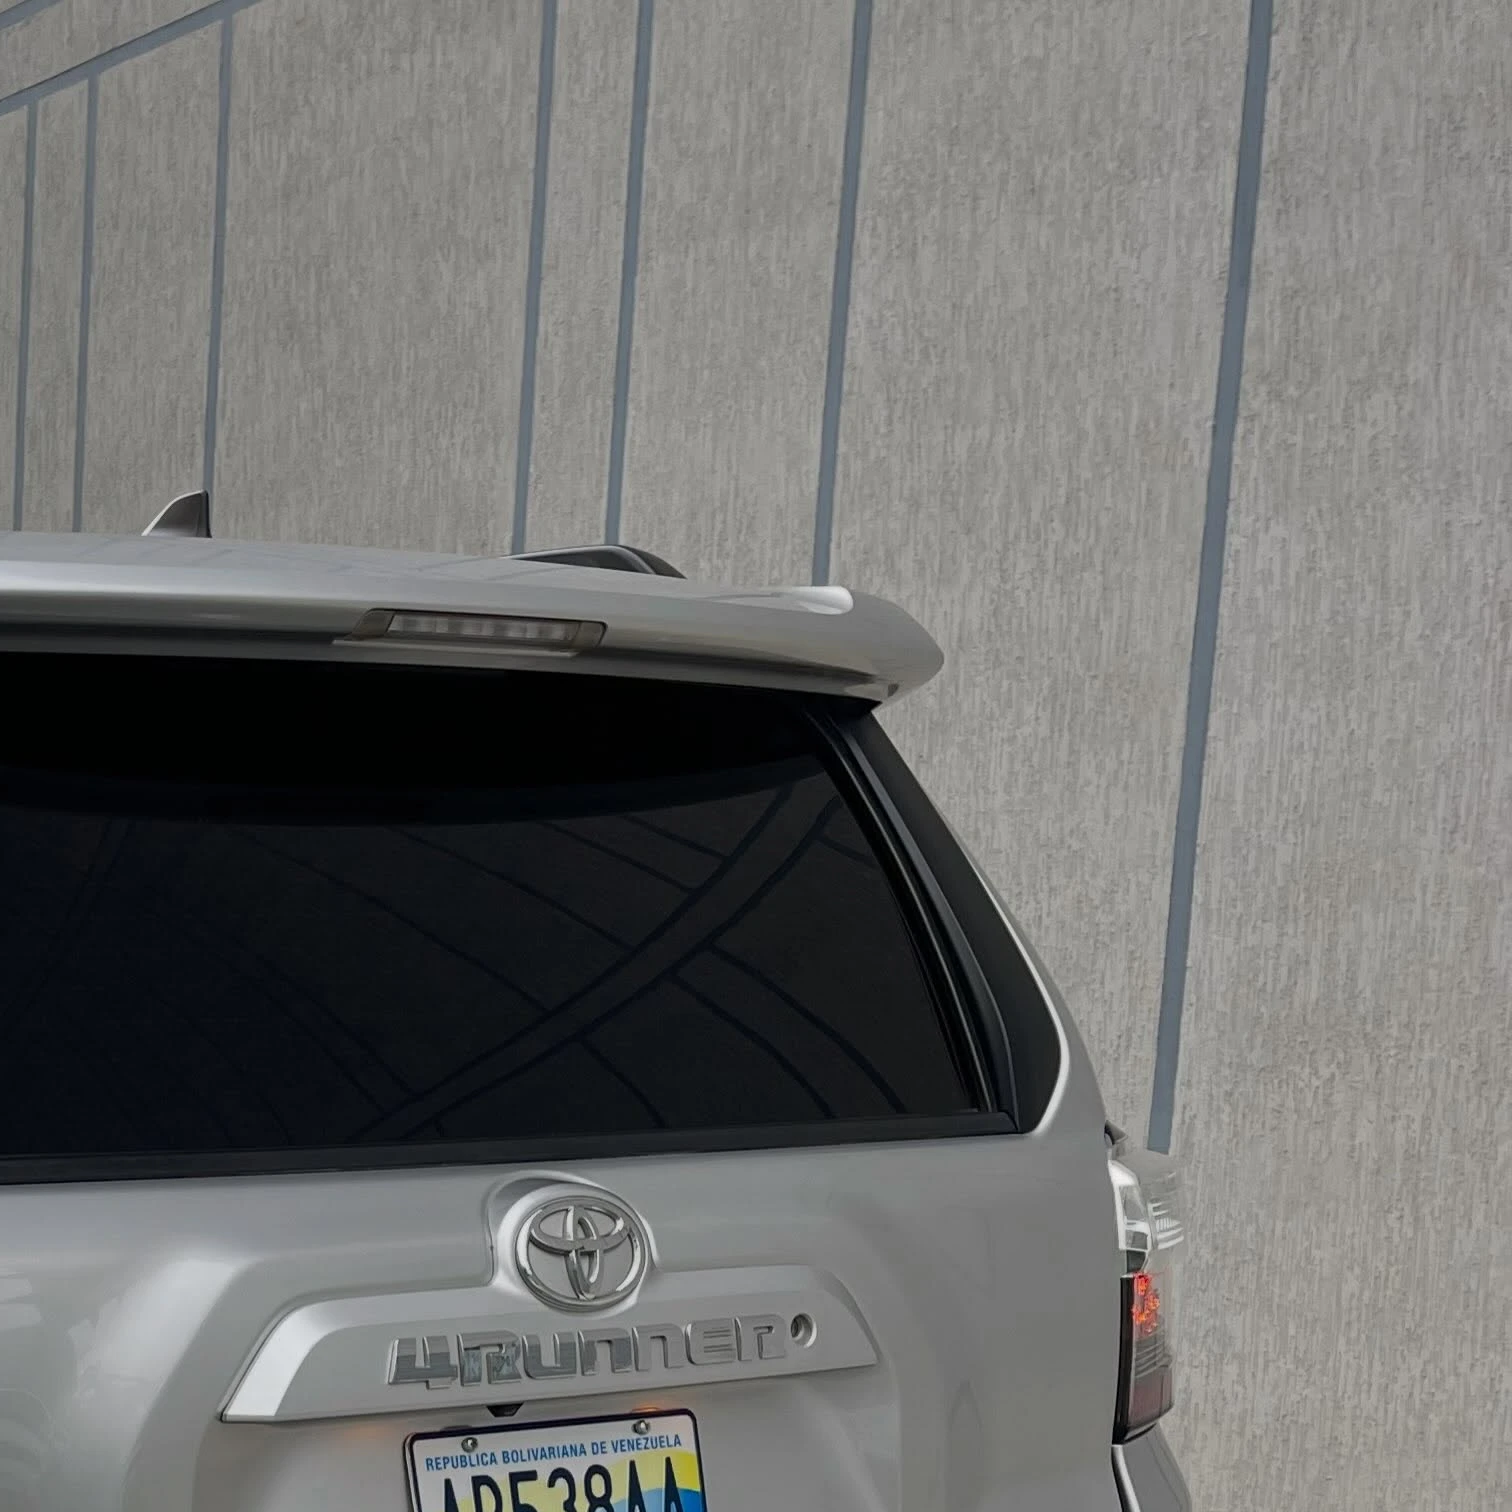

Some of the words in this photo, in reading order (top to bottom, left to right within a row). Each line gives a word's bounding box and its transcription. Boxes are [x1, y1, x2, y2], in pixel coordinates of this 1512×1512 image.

[425, 1451, 498, 1472] REPUBLICA
[502, 1441, 587, 1465] BOLIVARIANA
[591, 1440, 608, 1456] DE
[612, 1434, 682, 1453] VENEZUELA
